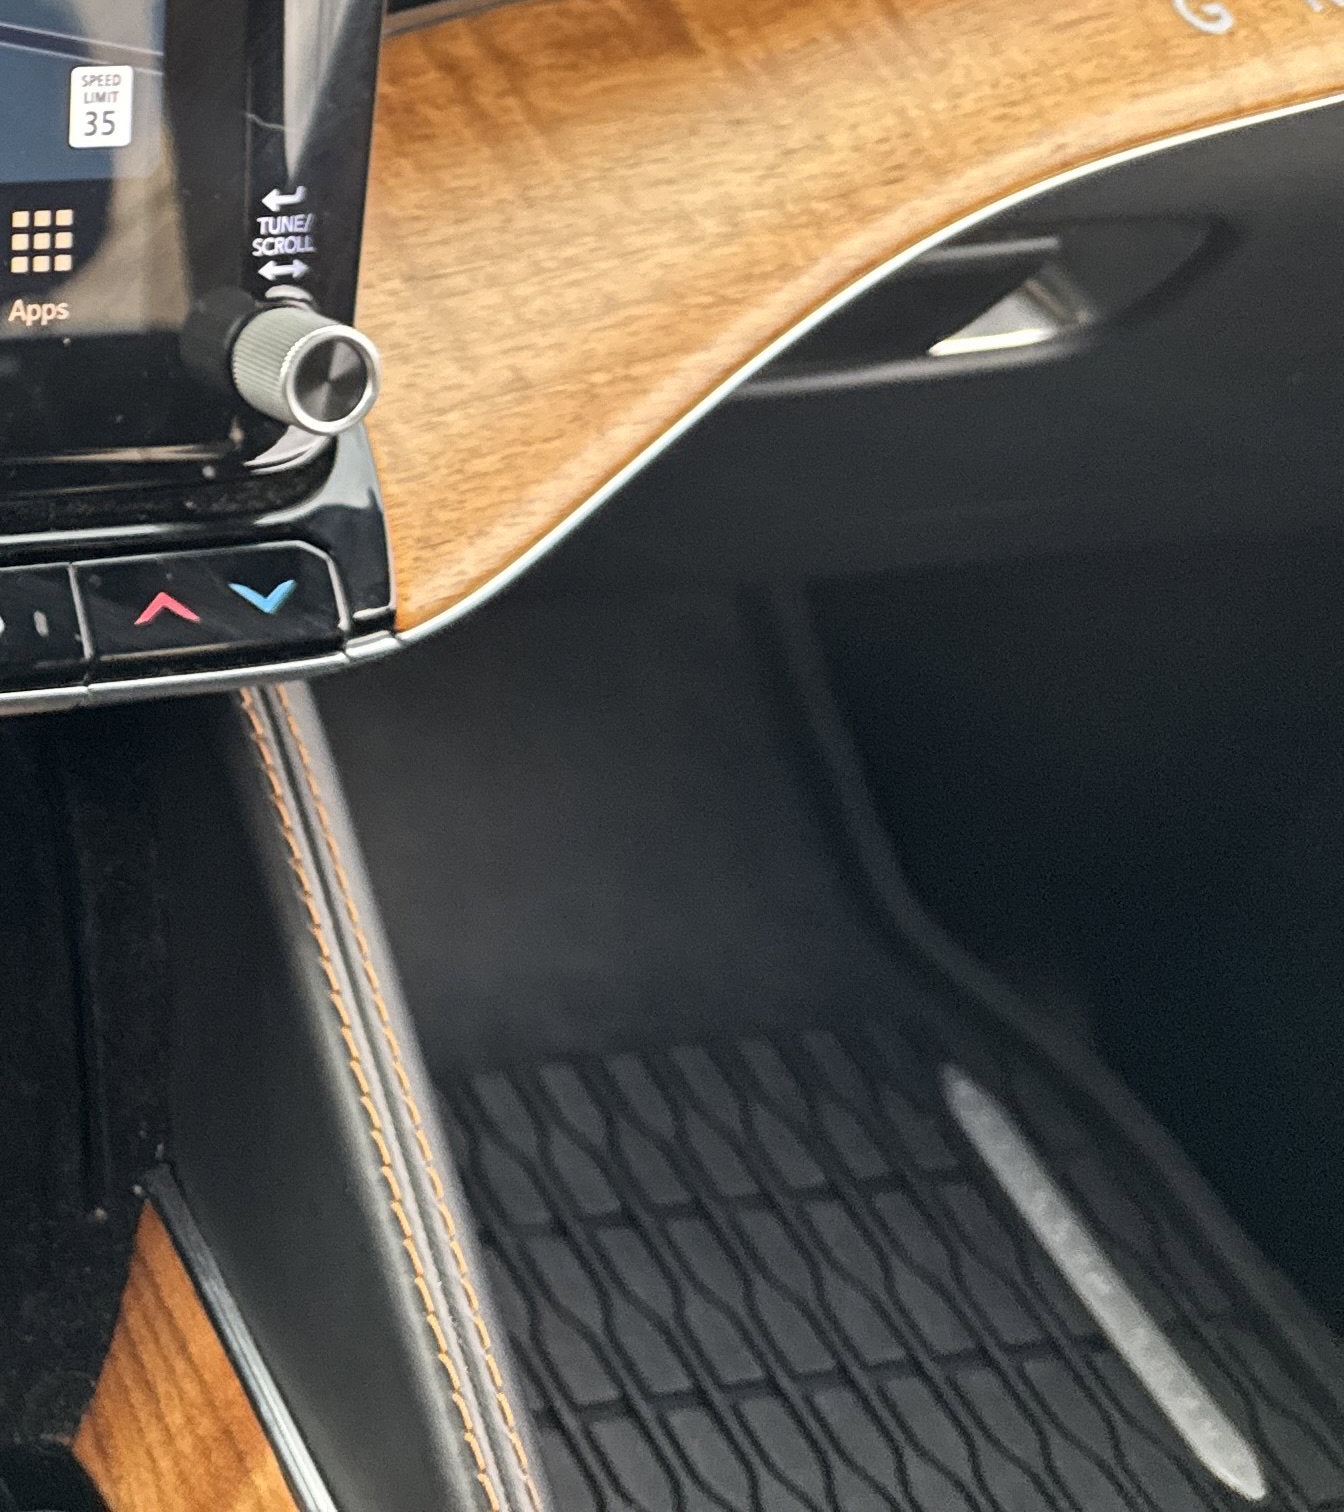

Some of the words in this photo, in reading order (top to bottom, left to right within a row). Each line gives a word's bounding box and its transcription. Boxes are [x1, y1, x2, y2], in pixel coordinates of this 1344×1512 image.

[81, 74, 122, 88] SPEED
[83, 91, 120, 104] LIMIT
[84, 110, 116, 137] 35
[251, 234, 317, 258] SCROLL
[8, 299, 70, 328] Apps
